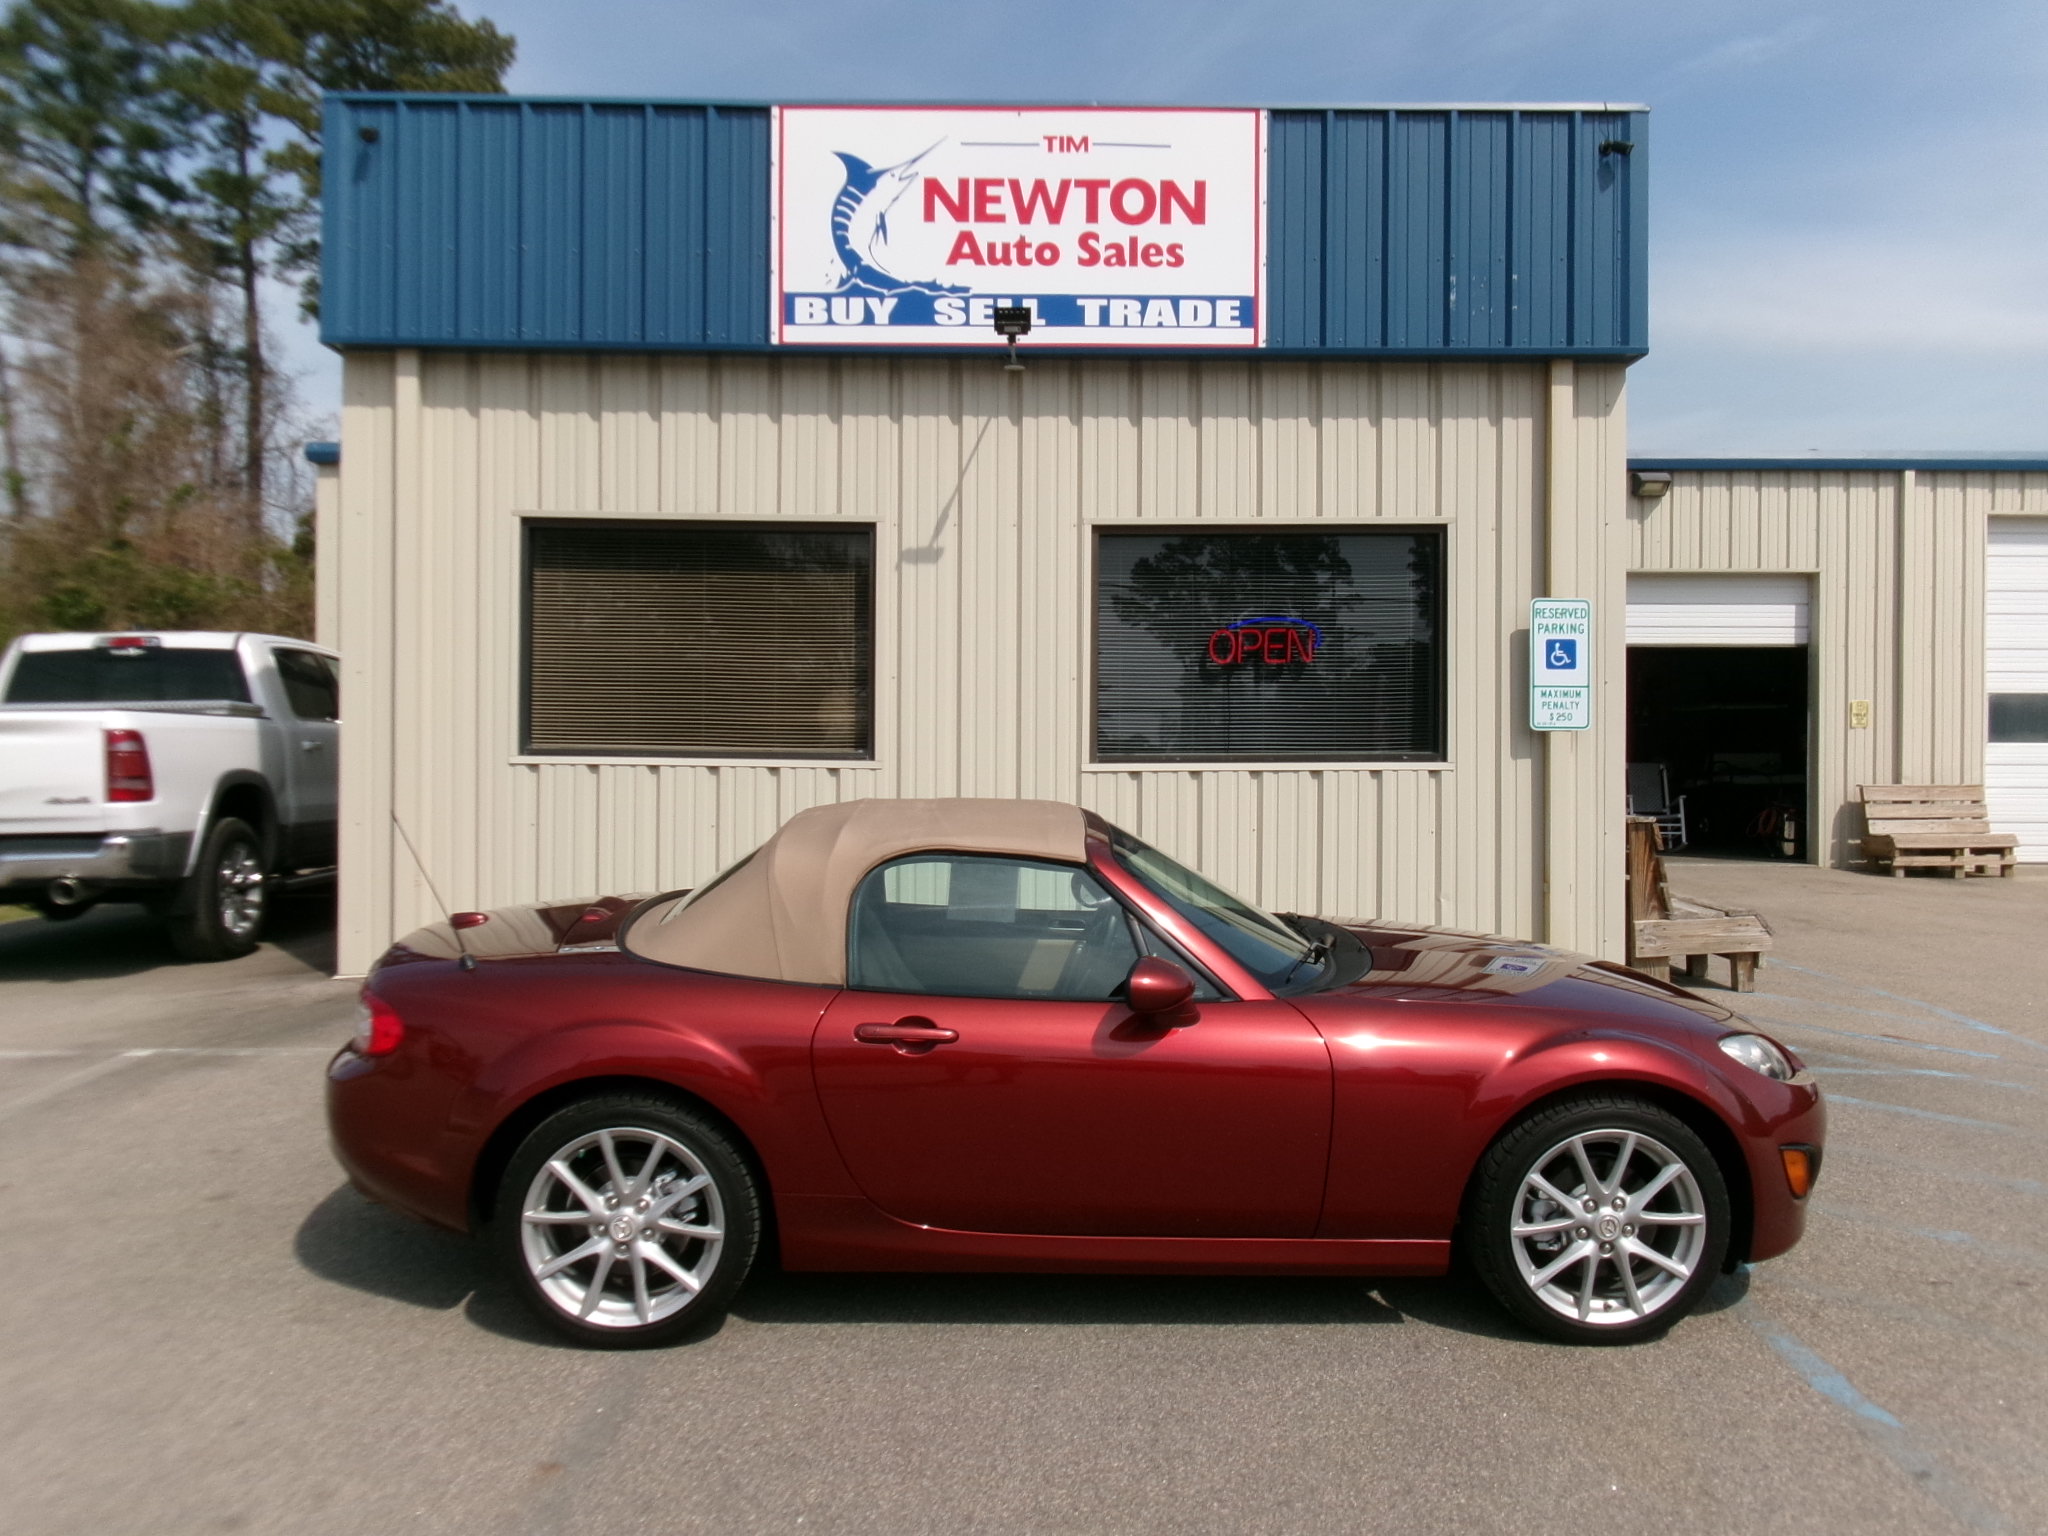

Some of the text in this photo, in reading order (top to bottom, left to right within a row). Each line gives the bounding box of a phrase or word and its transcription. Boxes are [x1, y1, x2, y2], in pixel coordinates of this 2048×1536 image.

[1043, 136, 1089, 153] TIM
[923, 177, 1206, 225] NEWTON
[946, 231, 1185, 268] Auto Sales
[794, 297, 1241, 328] BUY SEL TRADE
[1535, 608, 1587, 619] RESERVED
[1537, 623, 1585, 634] PARKING
[1209, 628, 1313, 664] OPEN
[1540, 690, 1582, 699] MAXIMUM
[1541, 701, 1580, 710] PENALTY
